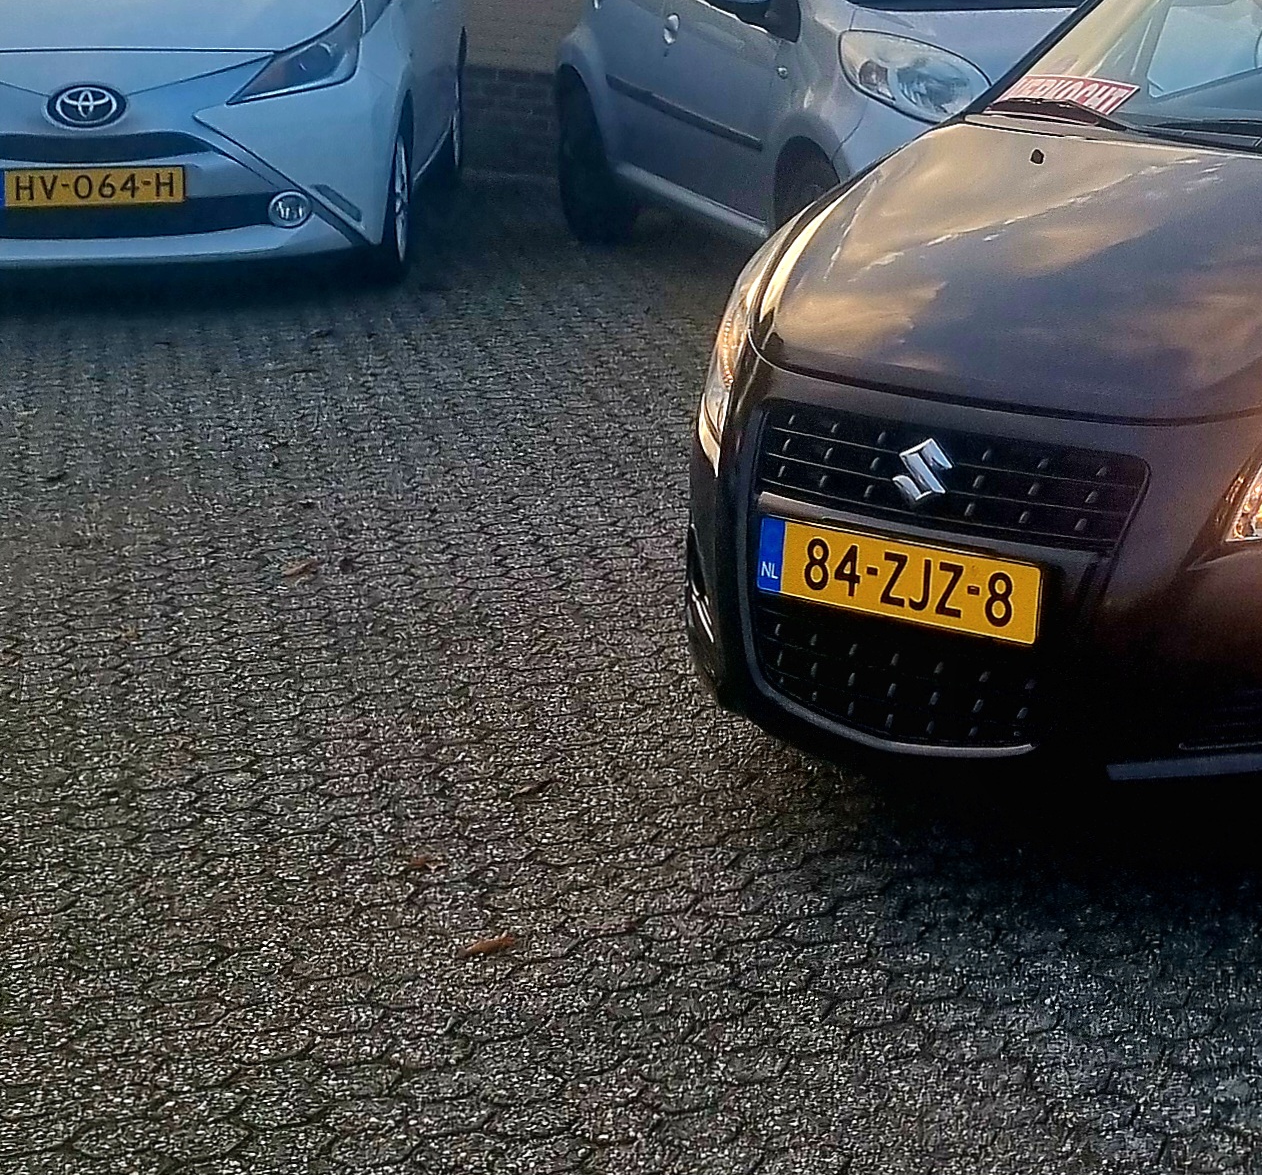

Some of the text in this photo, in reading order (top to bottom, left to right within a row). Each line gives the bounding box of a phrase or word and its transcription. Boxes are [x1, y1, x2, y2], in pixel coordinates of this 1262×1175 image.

[15, 172, 174, 201] HV-064-H
[761, 561, 779, 580] NL
[804, 537, 1013, 628] 84-ZJZ-8
